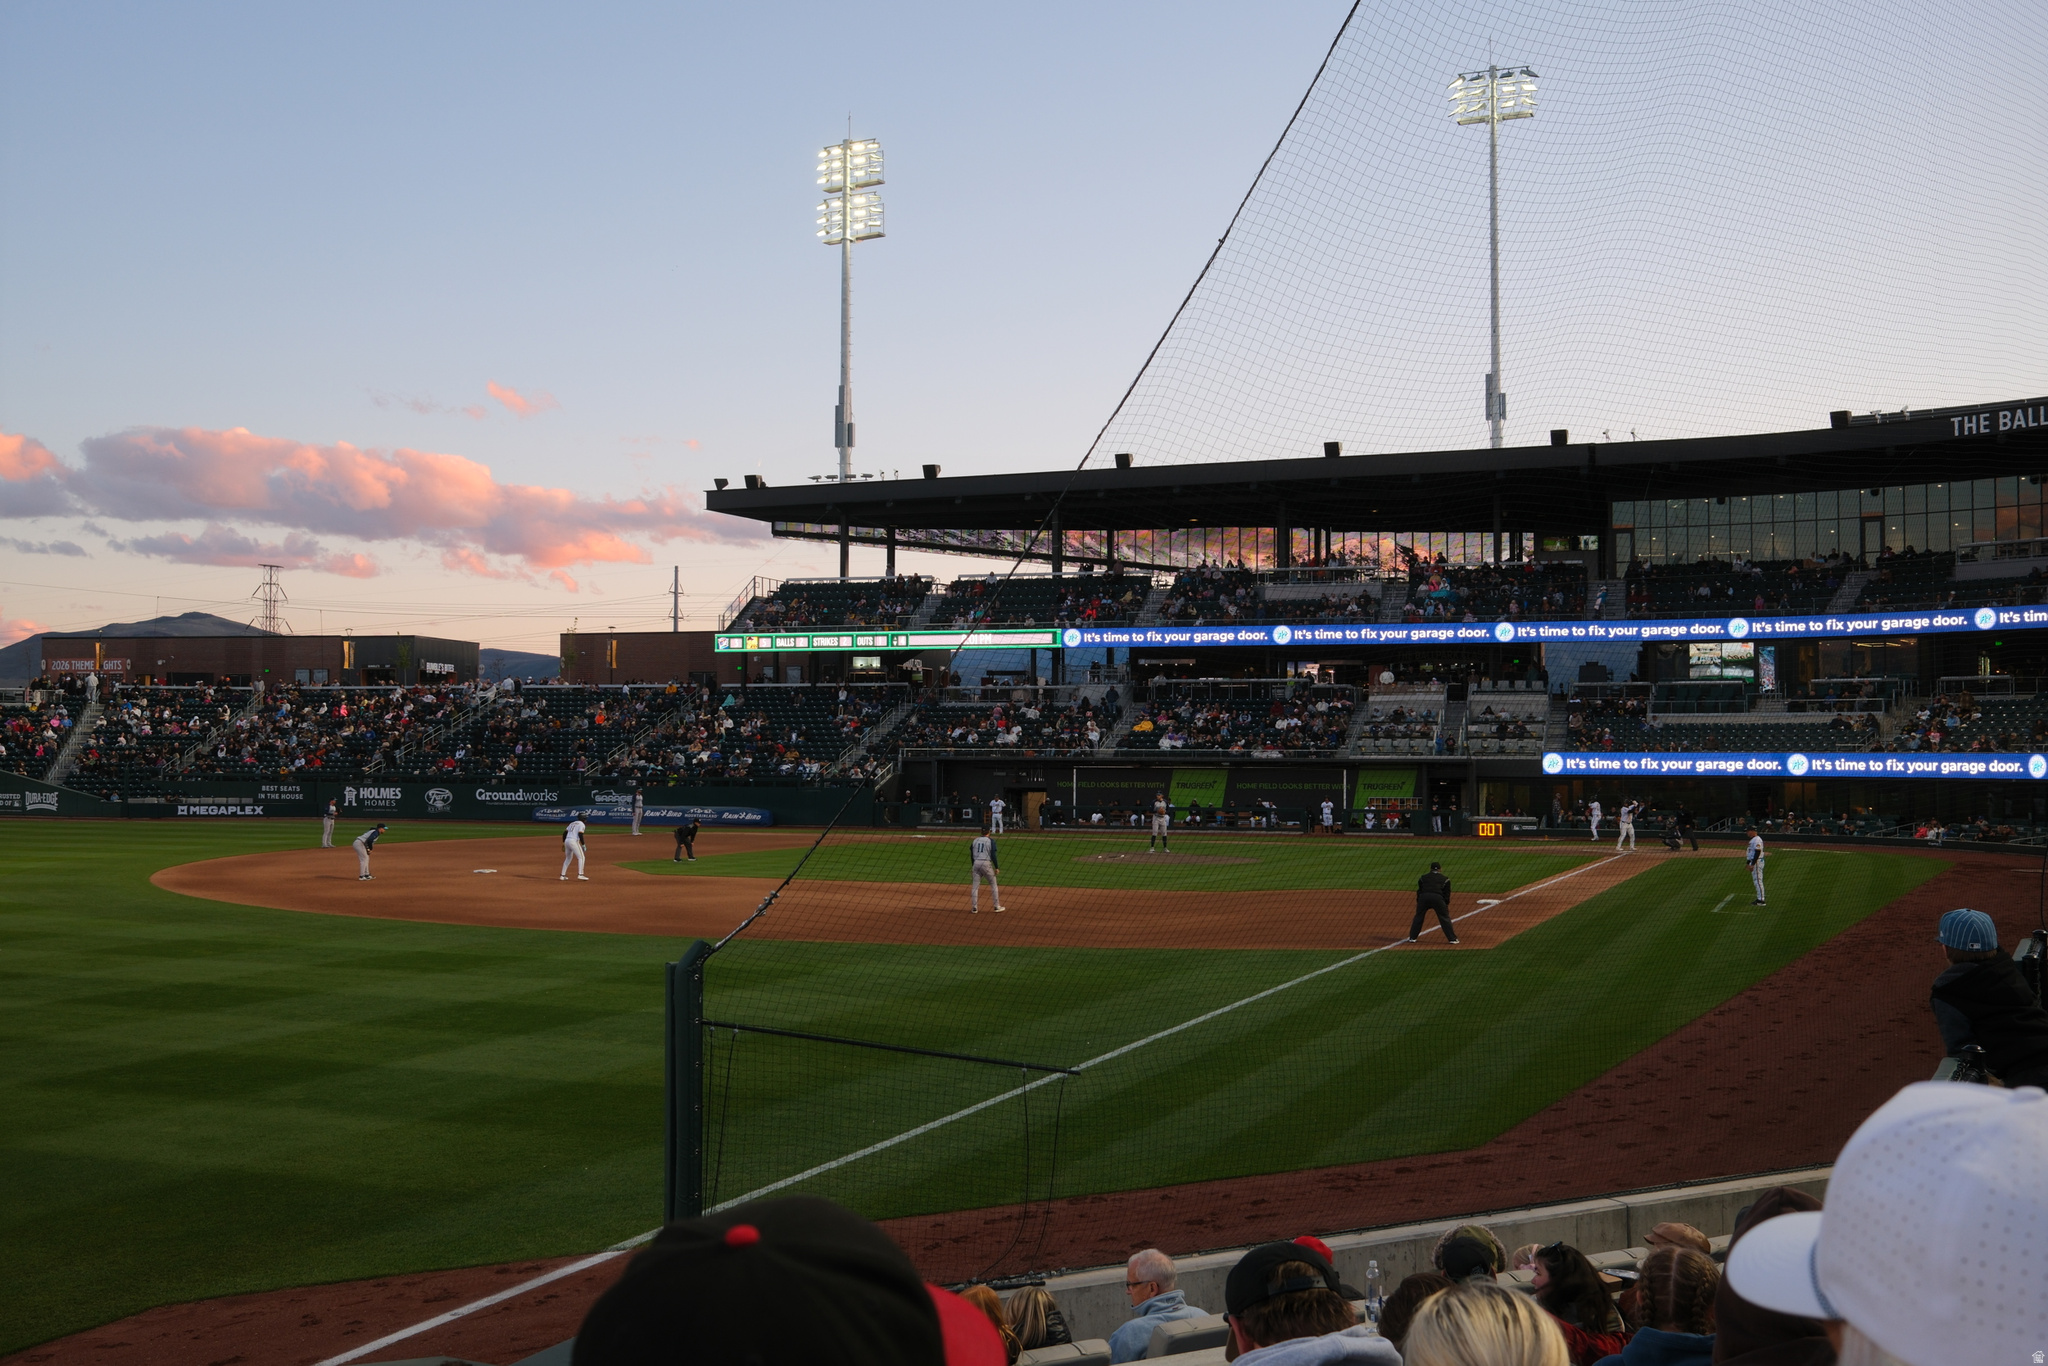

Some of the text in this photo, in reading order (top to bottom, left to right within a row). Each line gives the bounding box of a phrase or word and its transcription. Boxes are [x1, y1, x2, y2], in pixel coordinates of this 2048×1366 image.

[1951, 413, 1990, 436] THE
[1753, 615, 1967, 632] It's time to fix your garage door.
[2000, 612, 2020, 624] It's
[1084, 630, 1268, 643] It's time to fix your garage door.
[1295, 627, 1489, 641] It's time to fix your garage door.
[1518, 624, 1724, 638] It's time to fix your garage door.
[776, 637, 805, 647] BALLS 2
[812, 637, 848, 647] STRIKES 2
[857, 636, 873, 646] OUTS
[979, 634, 992, 645] PM
[52, 661, 122, 670] 2026 THEME GHTS
[1567, 758, 1781, 772] It's time to fix your garage door.
[1812, 759, 2023, 774] It's time to fix your garage door.
[1121, 781, 1146, 789] BETTER
[1147, 781, 1165, 789] WITH
[1176, 782, 1215, 790] TRUGREEN
[1363, 783, 1403, 791] TRUGREEN
[25, 791, 59, 806] DURA-EDGE
[360, 787, 401, 799] HOLMES
[475, 788, 558, 801] Groundworks
[190, 805, 263, 815] MEGAPLEX
[666, 810, 682, 818] BIRD
[977, 843, 984, 853] 11
